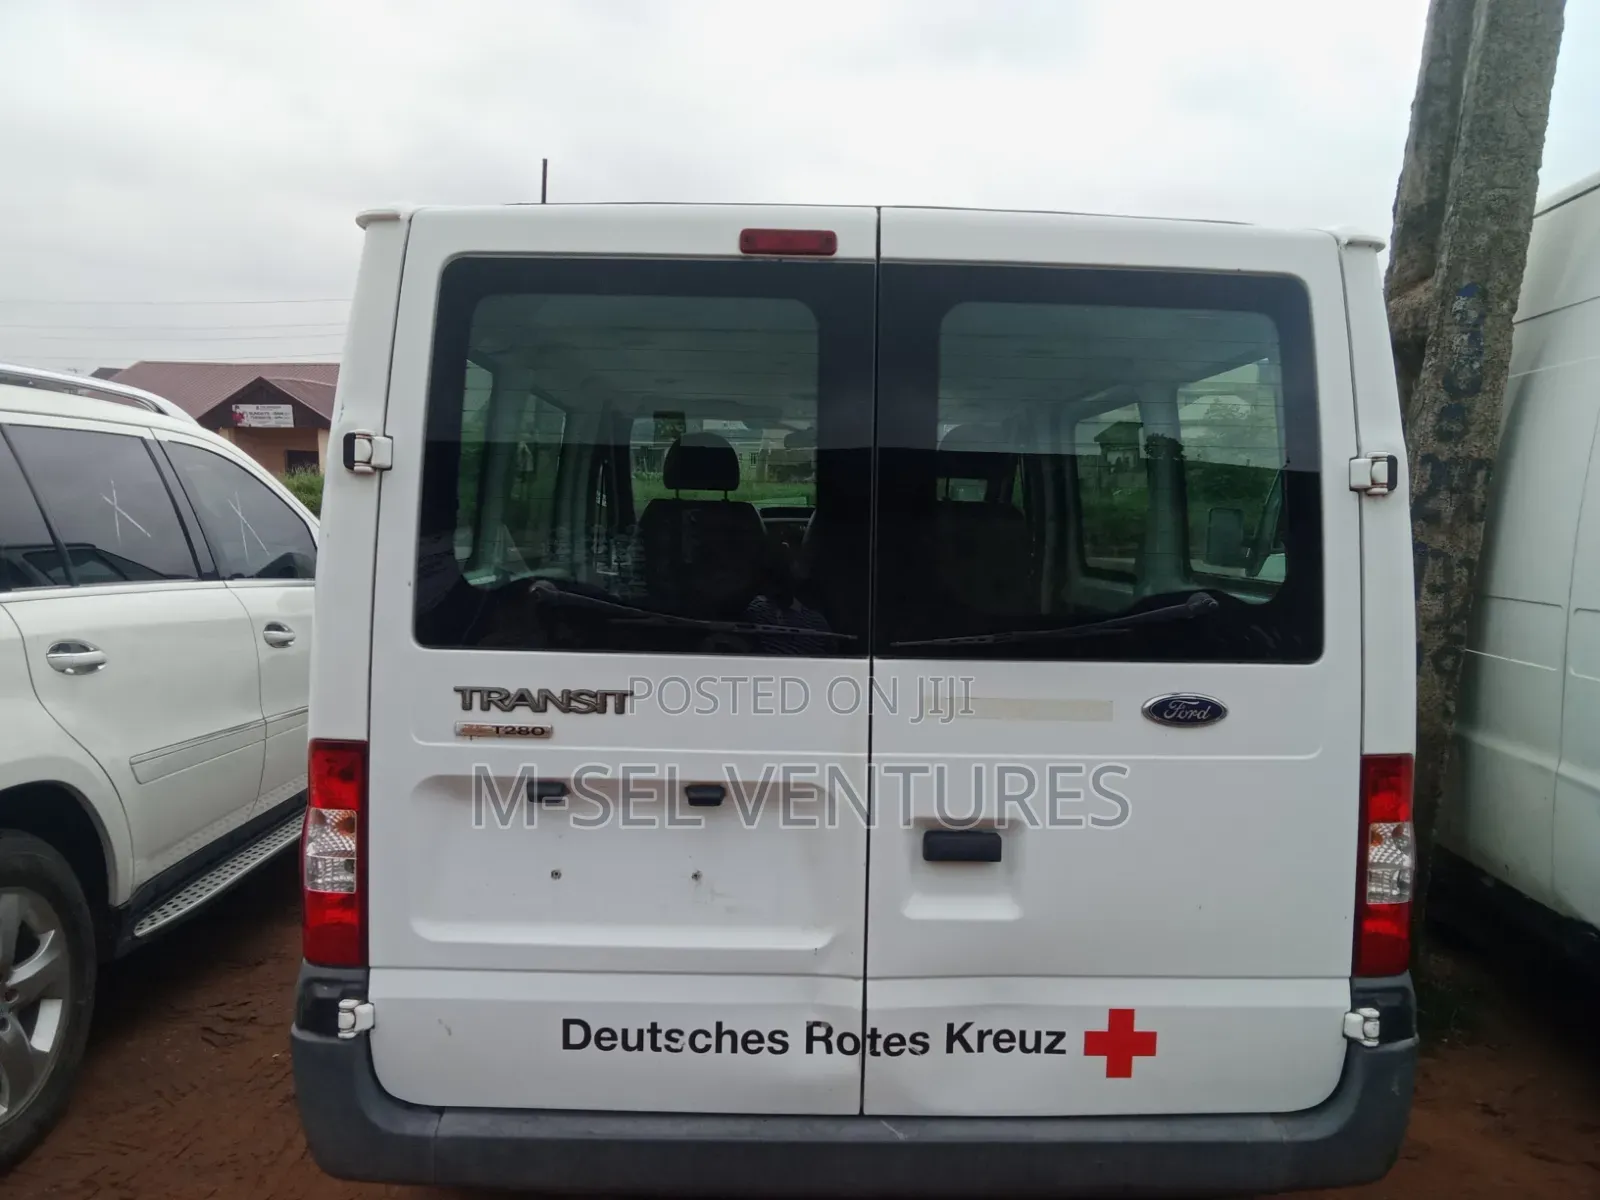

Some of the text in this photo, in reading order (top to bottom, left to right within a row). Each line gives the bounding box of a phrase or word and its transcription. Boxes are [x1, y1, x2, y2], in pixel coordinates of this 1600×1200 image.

[454, 686, 634, 714] TRANSIT
[1164, 700, 1211, 719] Ford
[491, 725, 545, 736] T280
[561, 1018, 1067, 1057] Deutsches Rotes Kreuz
